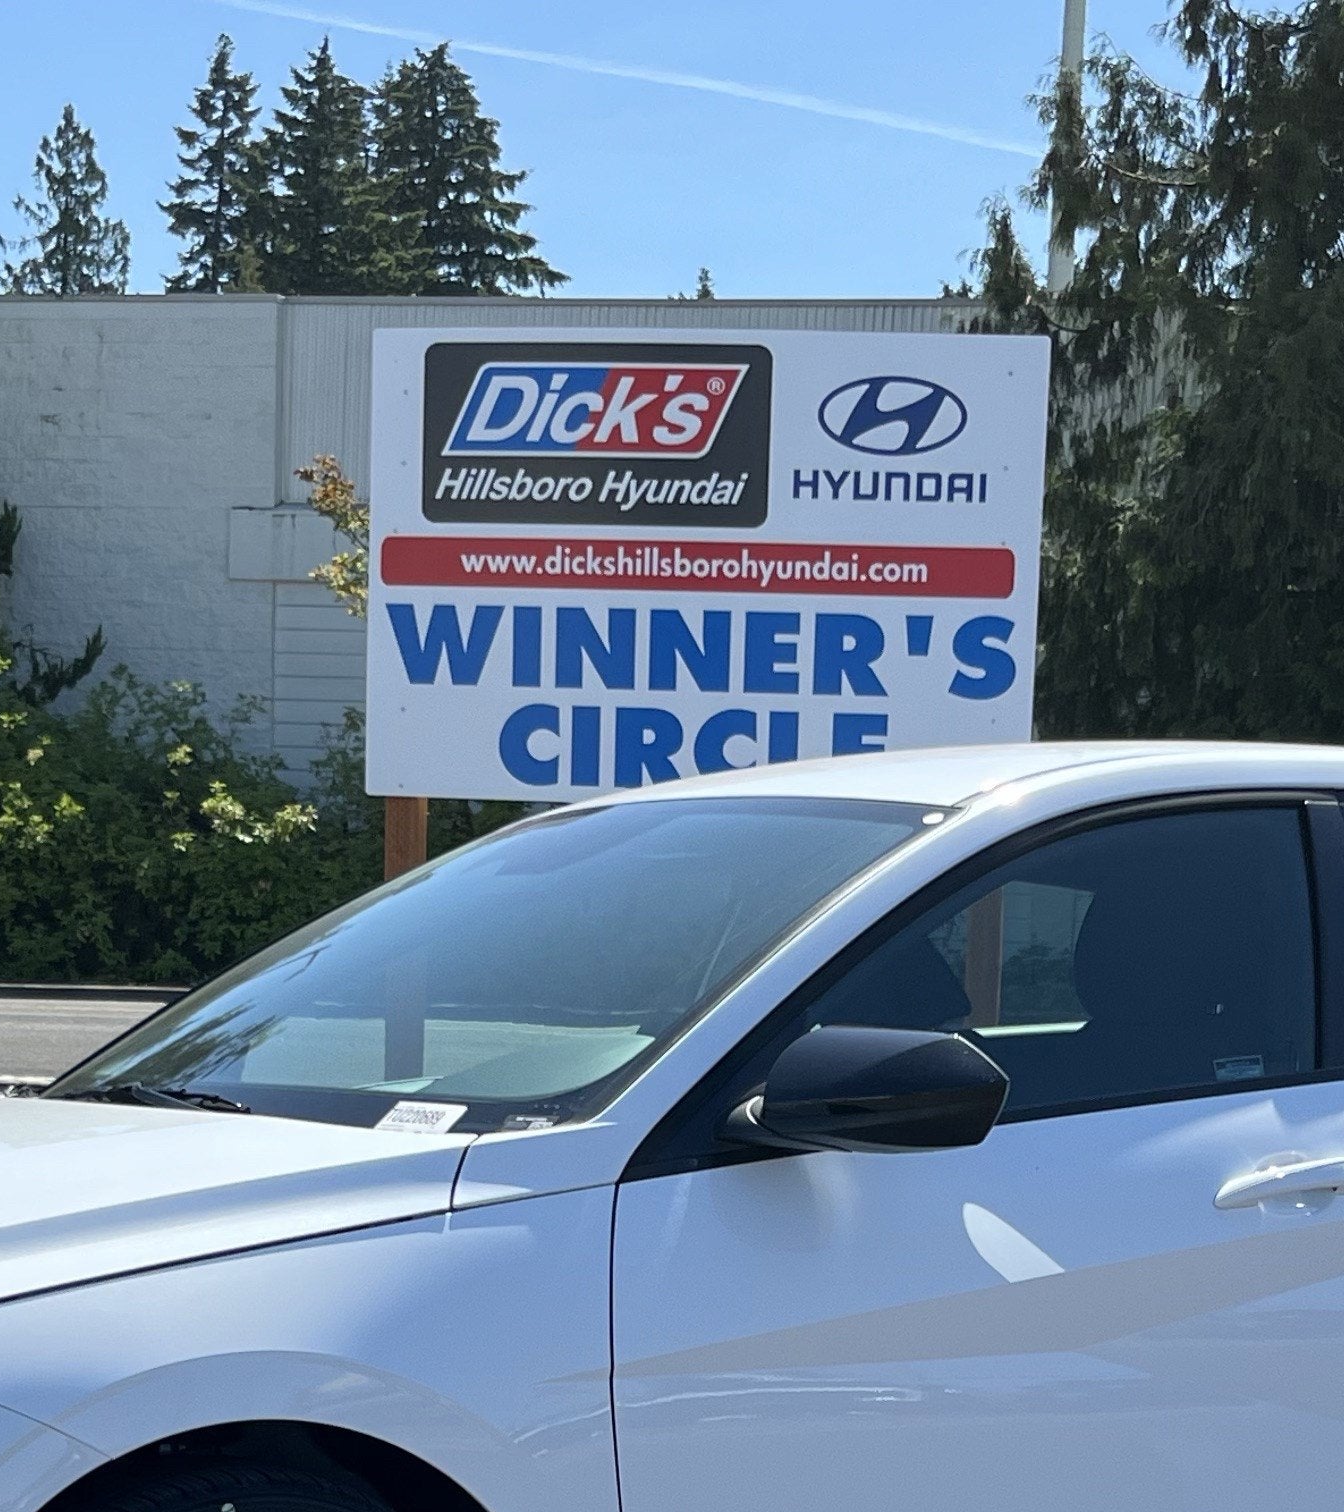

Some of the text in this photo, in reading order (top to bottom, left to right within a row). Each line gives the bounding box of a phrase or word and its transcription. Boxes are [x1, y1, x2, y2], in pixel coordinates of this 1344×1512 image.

[465, 372, 710, 446] Dick's
[435, 468, 749, 511] Hillsboro Hyundai
[792, 469, 987, 503] HYUNDAI
[460, 544, 928, 586] www.dickshillsborohyundai.com
[386, 602, 1017, 700] WINNER'S
